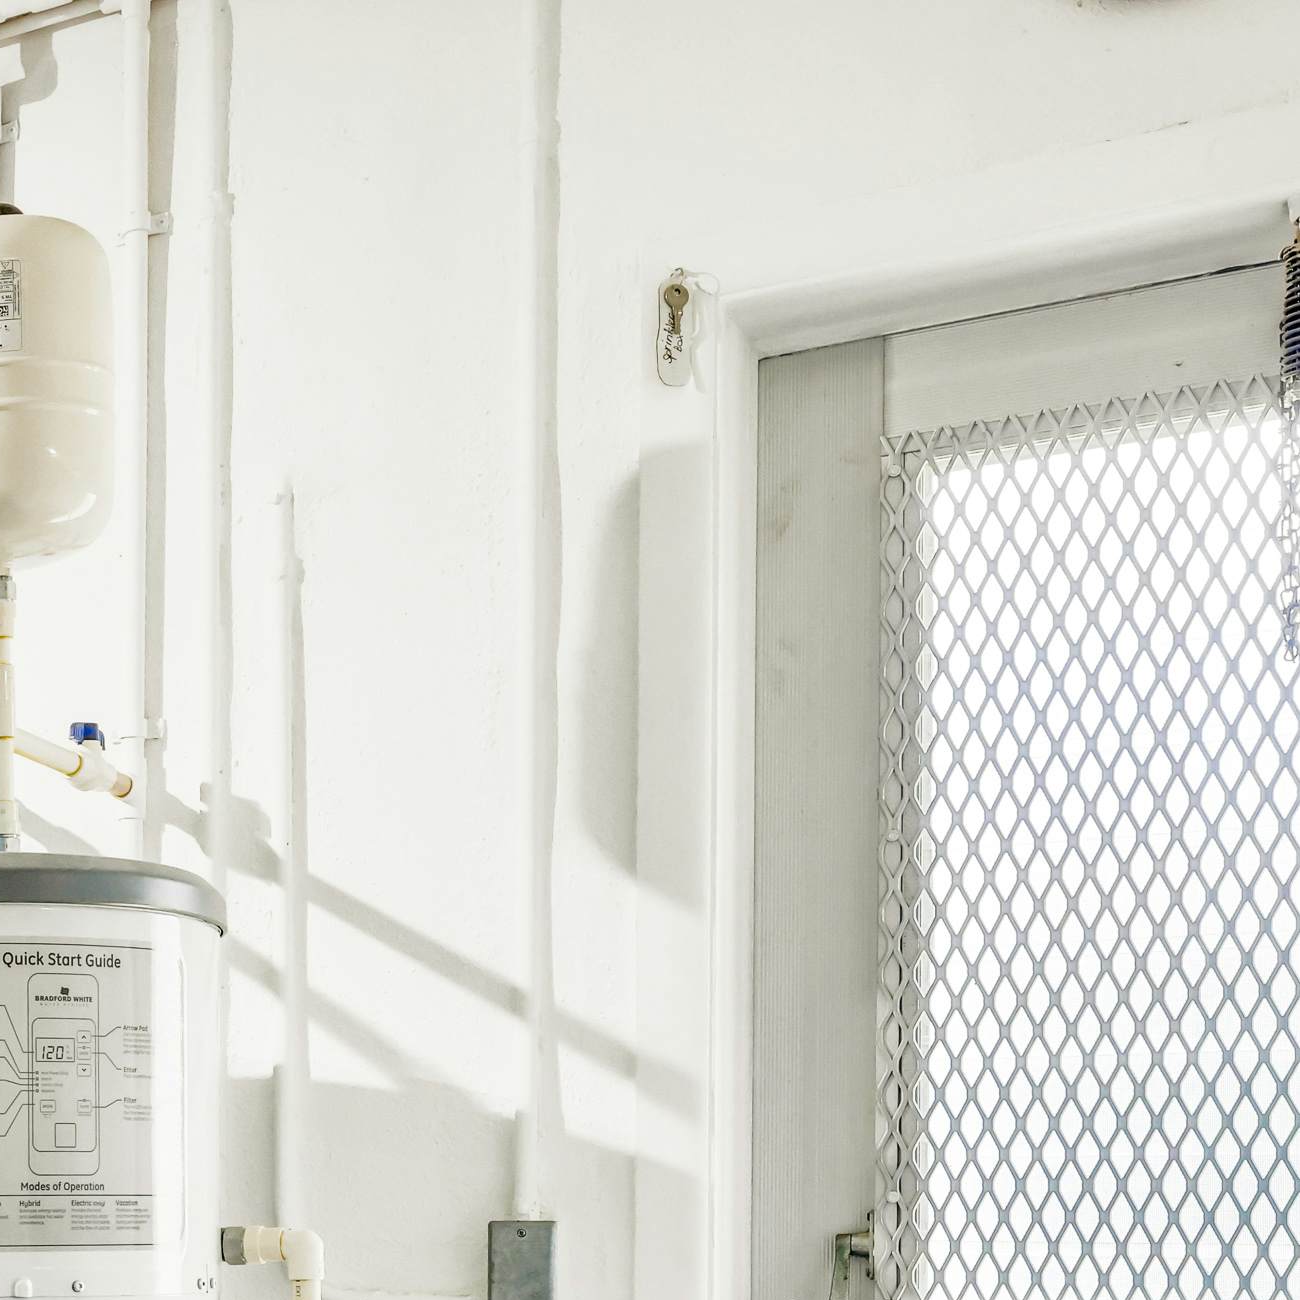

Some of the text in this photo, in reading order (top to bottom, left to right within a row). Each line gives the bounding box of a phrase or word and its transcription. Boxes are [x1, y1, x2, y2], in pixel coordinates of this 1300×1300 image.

[2, 951, 121, 968] Quick Start Guide
[41, 1045, 65, 1060] 120
[20, 1182, 105, 1192] Modes of Operation
